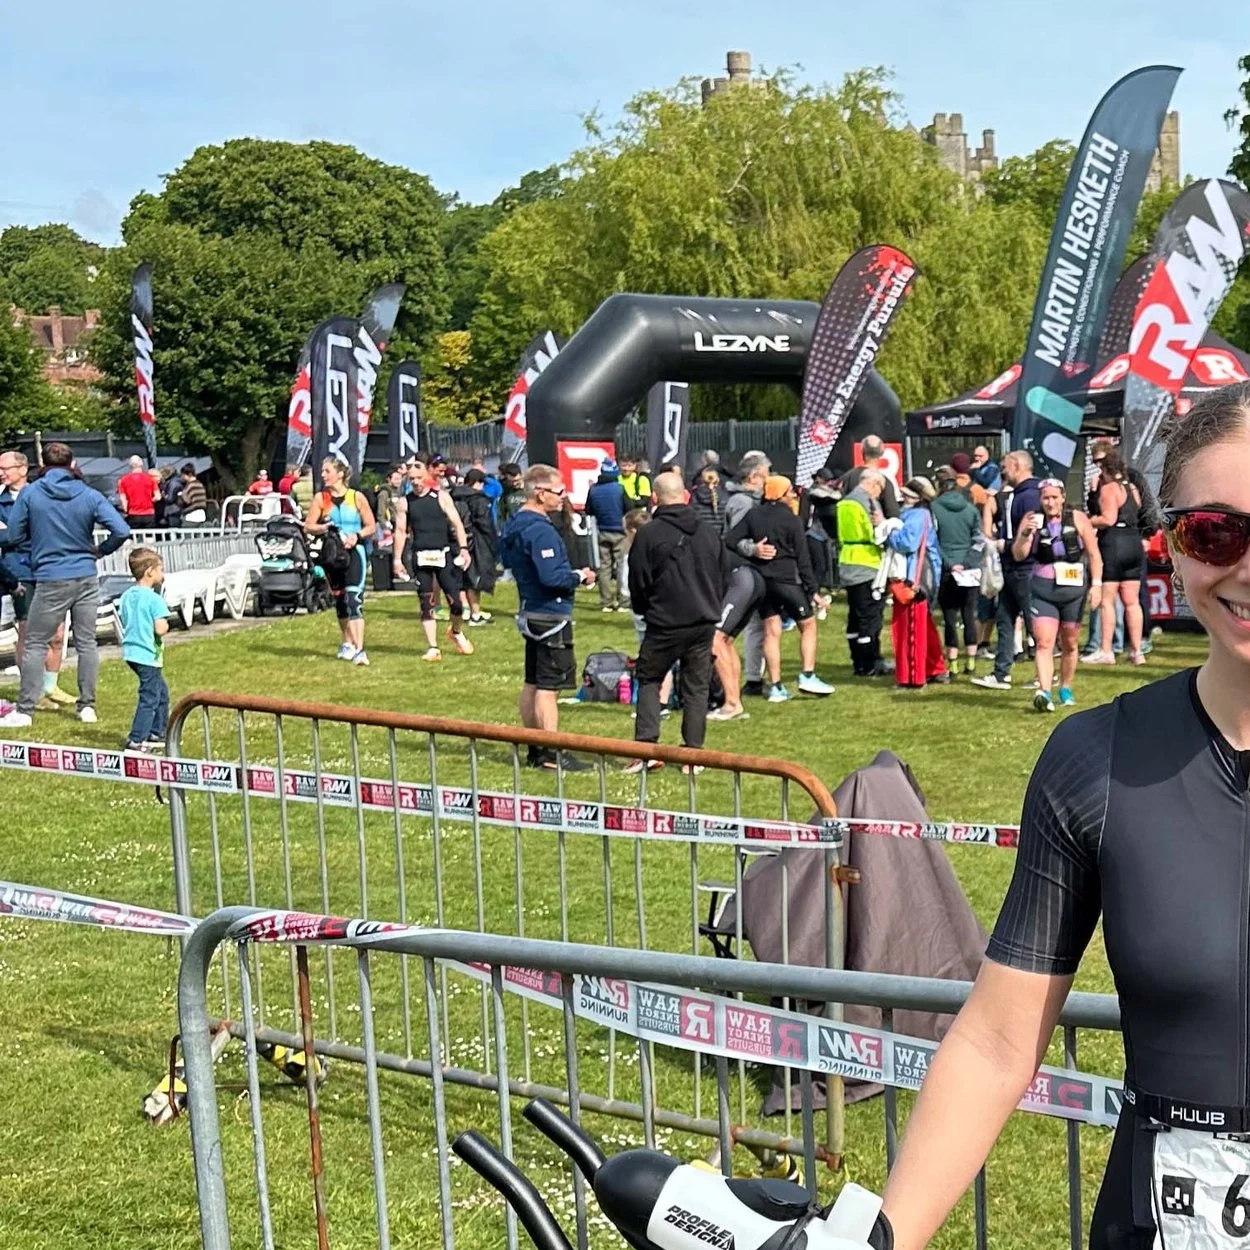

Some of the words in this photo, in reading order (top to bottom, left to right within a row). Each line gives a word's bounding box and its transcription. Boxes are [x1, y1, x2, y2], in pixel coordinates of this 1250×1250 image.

[1076, 258, 1099, 322] CONDITIONING
[1094, 182, 1120, 250] PERFORMANCE
[1114, 149, 1130, 183] COACH
[1034, 258, 1084, 367] MARTIN
[1061, 132, 1119, 260] HESKETH
[694, 331, 791, 352] LEZYNE
[839, 334, 883, 402] Energy
[177, 763, 197, 774] RAW
[203, 766, 231, 780] RAW
[253, 771, 274, 782] RAW
[323, 778, 350, 793] RAW
[443, 792, 471, 806] RAW
[539, 802, 560, 814] RAW
[568, 804, 597, 819] RAW
[623, 810, 647, 821] RAW
[704, 830, 740, 839] RUNNING
[953, 826, 989, 841] RAW
[1171, 1106, 1225, 1125] HUUB
[668, 1204, 731, 1238] PROFILE
[664, 1214, 728, 1250] DESIGN
